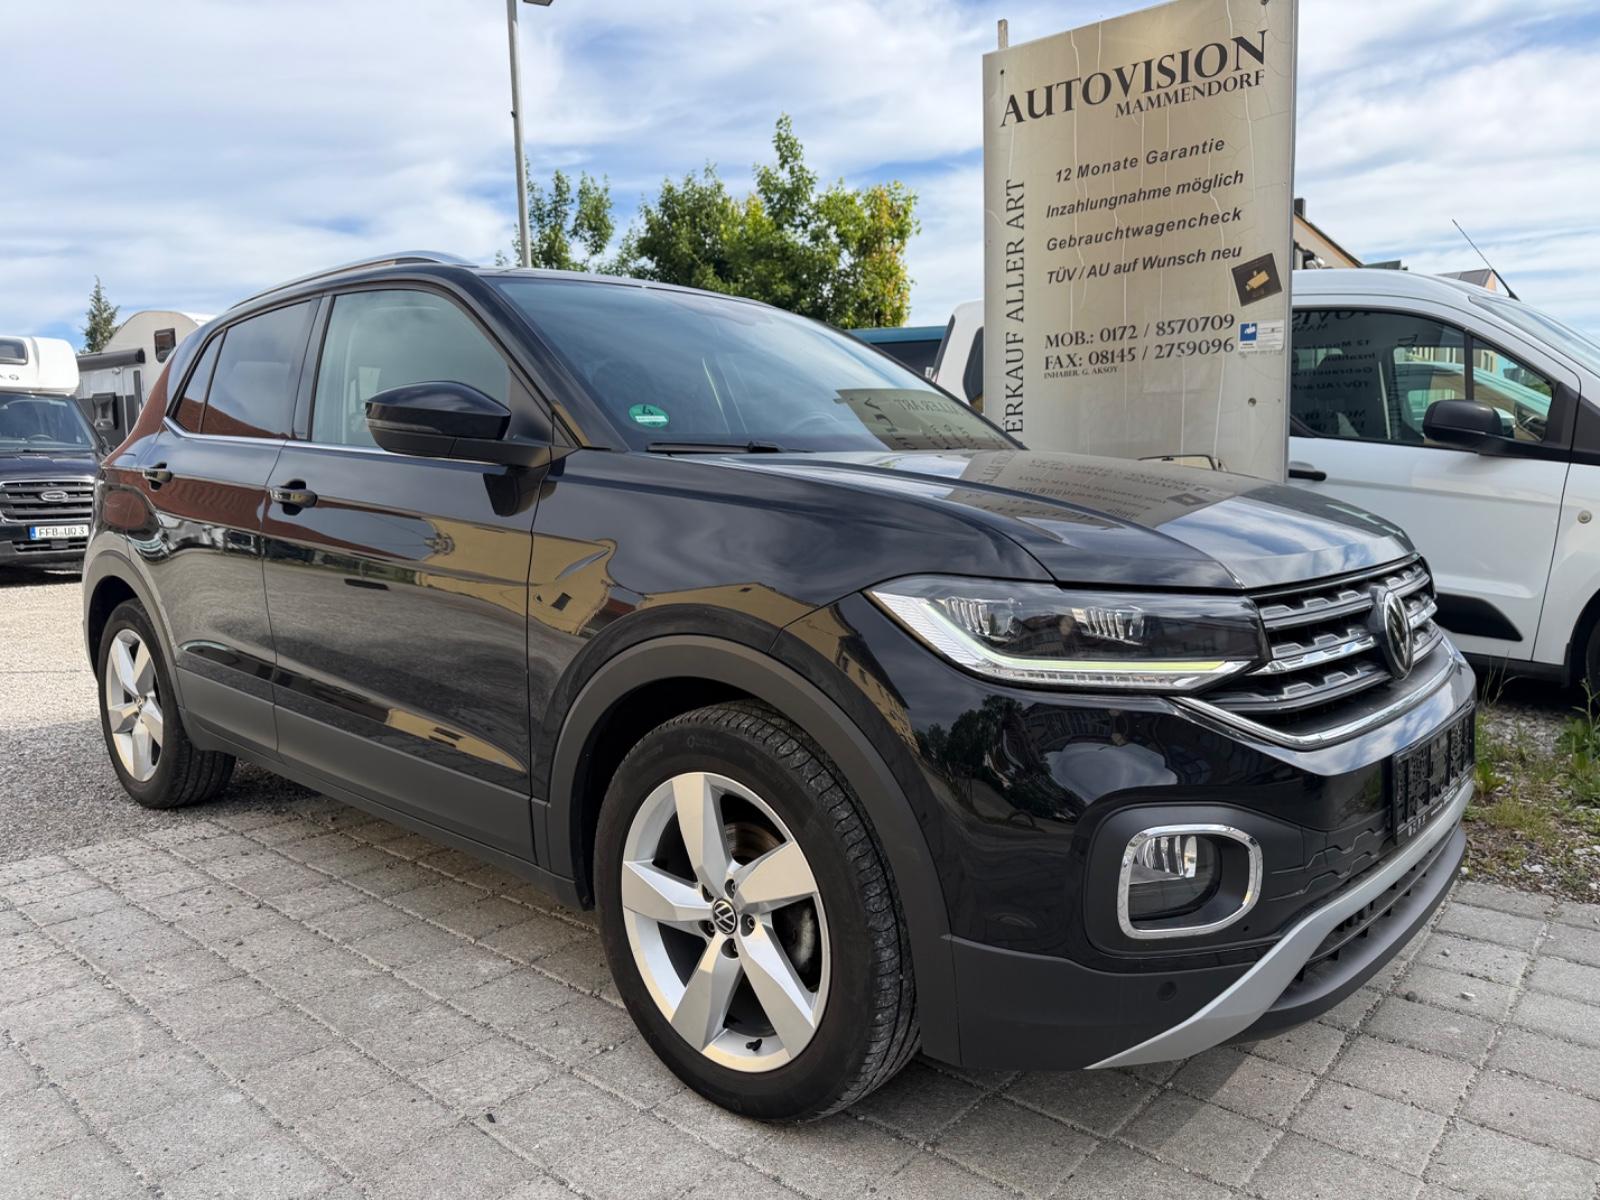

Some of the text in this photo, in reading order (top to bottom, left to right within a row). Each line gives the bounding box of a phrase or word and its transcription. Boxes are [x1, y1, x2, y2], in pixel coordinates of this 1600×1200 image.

[1000, 30, 1268, 127] AUTOVISION
[1115, 69, 1265, 118] MAMMENDORF
[1055, 138, 1226, 183] 12 Monate Garantie
[1046, 170, 1245, 218] Inzahlungnahme möglich
[1046, 207, 1243, 251] Gebrauchtwagencheck
[1047, 265, 1078, 285] TÜV
[1086, 261, 1111, 279] AU
[1112, 257, 1140, 275] auf
[1142, 248, 1207, 271] Wunsch
[1210, 246, 1243, 261] neu
[1004, 179, 1025, 434] ERKAUF ALLER ART
[1045, 331, 1094, 349] MOB.:
[1099, 325, 1139, 342] 0172
[1143, 323, 1151, 339] /
[1156, 314, 1236, 337] 8570709
[1045, 337, 1235, 370] FAX: 08145 / 2759096
